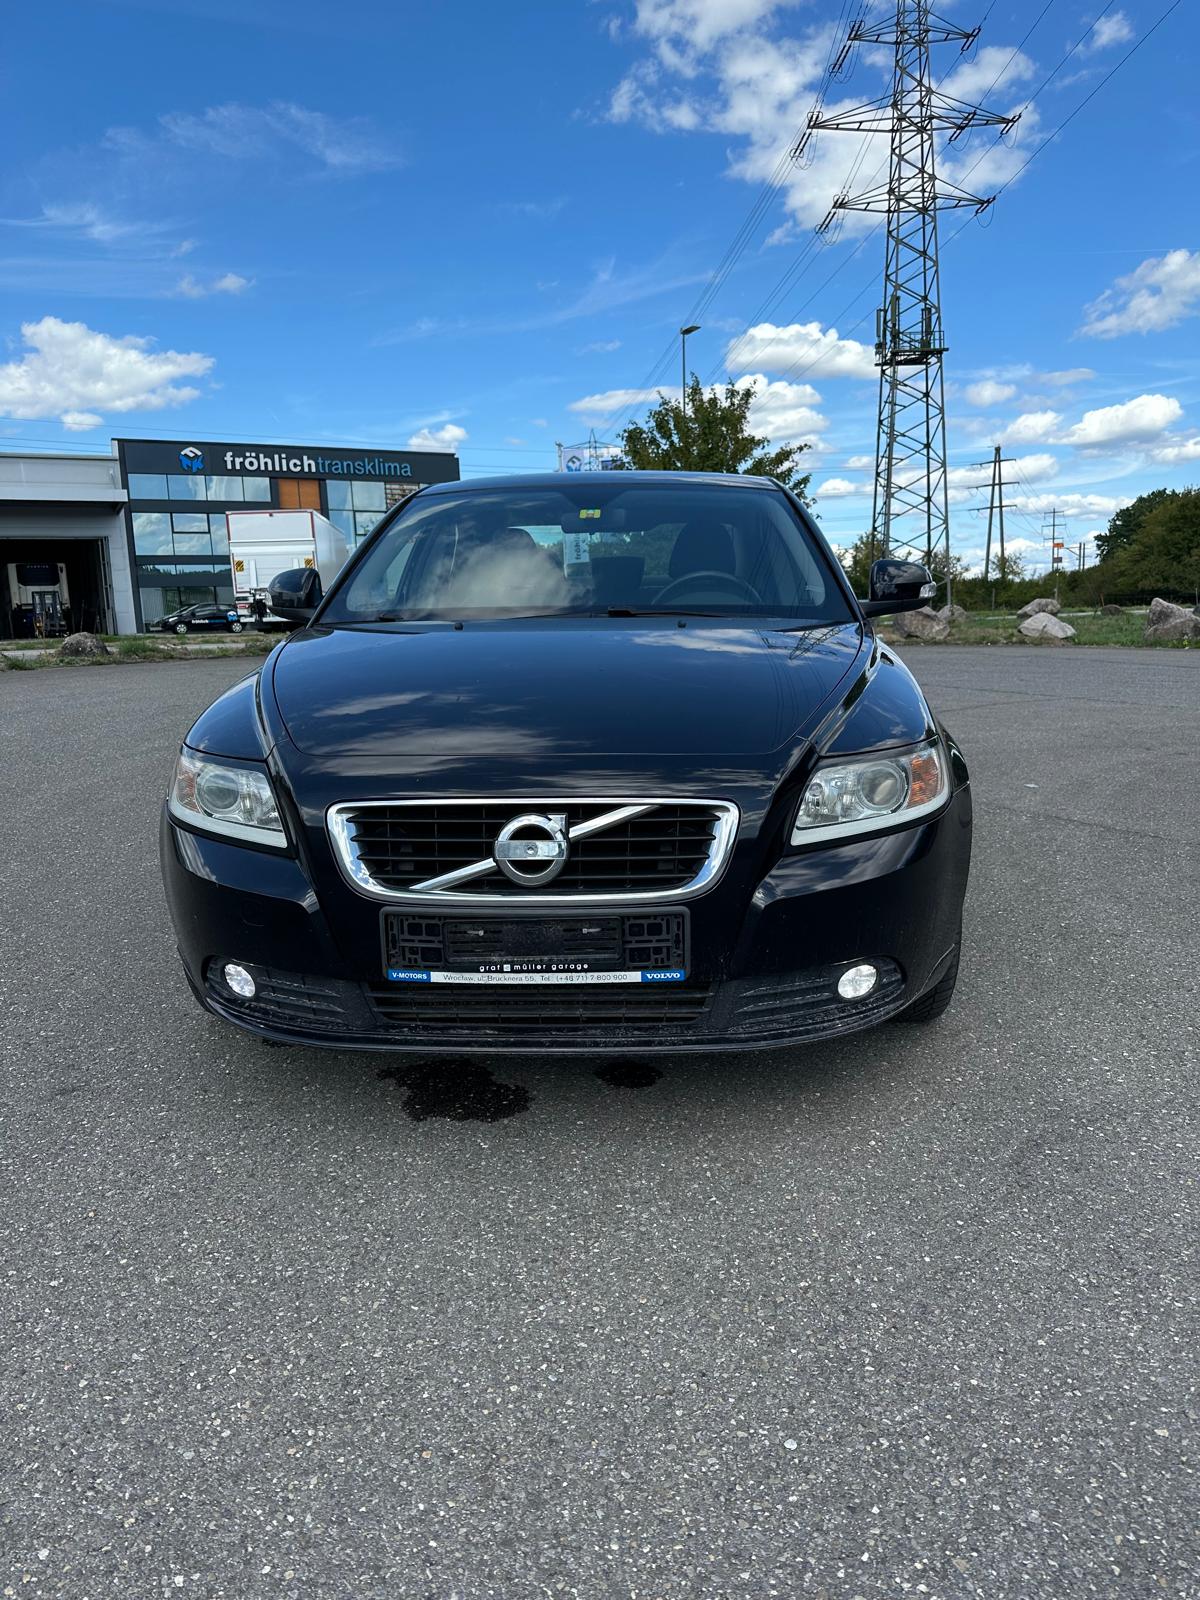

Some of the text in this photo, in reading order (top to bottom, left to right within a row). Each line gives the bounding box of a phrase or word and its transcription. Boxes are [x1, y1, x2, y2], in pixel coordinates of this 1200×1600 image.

[551, 963, 588, 971] garage
[392, 972, 427, 980] V-MOTORS
[646, 972, 681, 980] VOLVO
